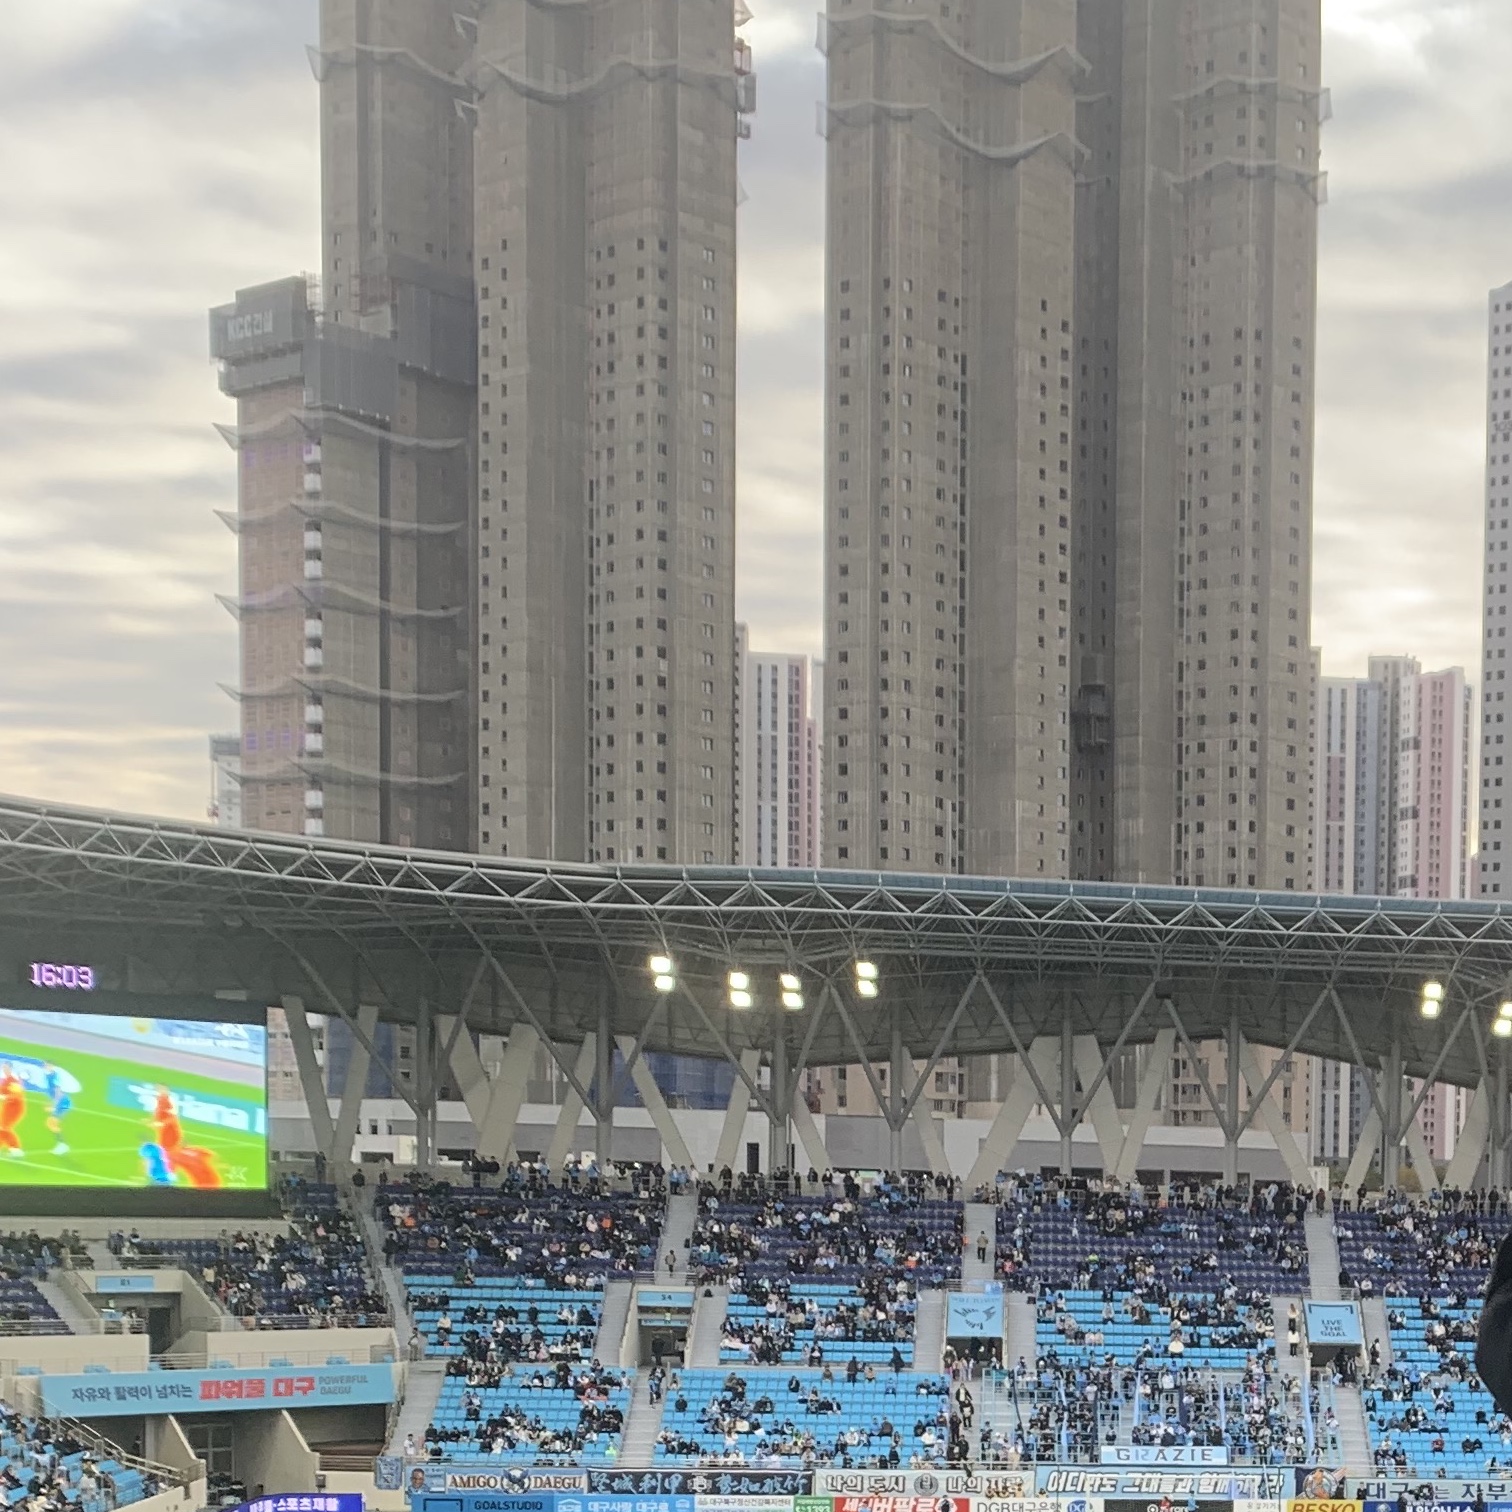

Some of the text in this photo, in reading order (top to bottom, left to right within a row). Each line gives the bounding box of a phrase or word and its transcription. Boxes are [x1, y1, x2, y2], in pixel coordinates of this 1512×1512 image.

[29, 962, 95, 990] 16:03
[72, 1387, 111, 1402] 자유와
[155, 1384, 193, 1400] 넘치는
[272, 1376, 315, 1397] 대구
[319, 1375, 368, 1385] POWERFUL
[450, 1475, 583, 1489] AMIGO DAEGU
[826, 1475, 863, 1492] 나의
[868, 1475, 906, 1493] 도시
[946, 1475, 983, 1493] 나의
[1366, 1482, 1450, 1501] 대구는
[474, 1500, 543, 1511] GOALSTUDIO
